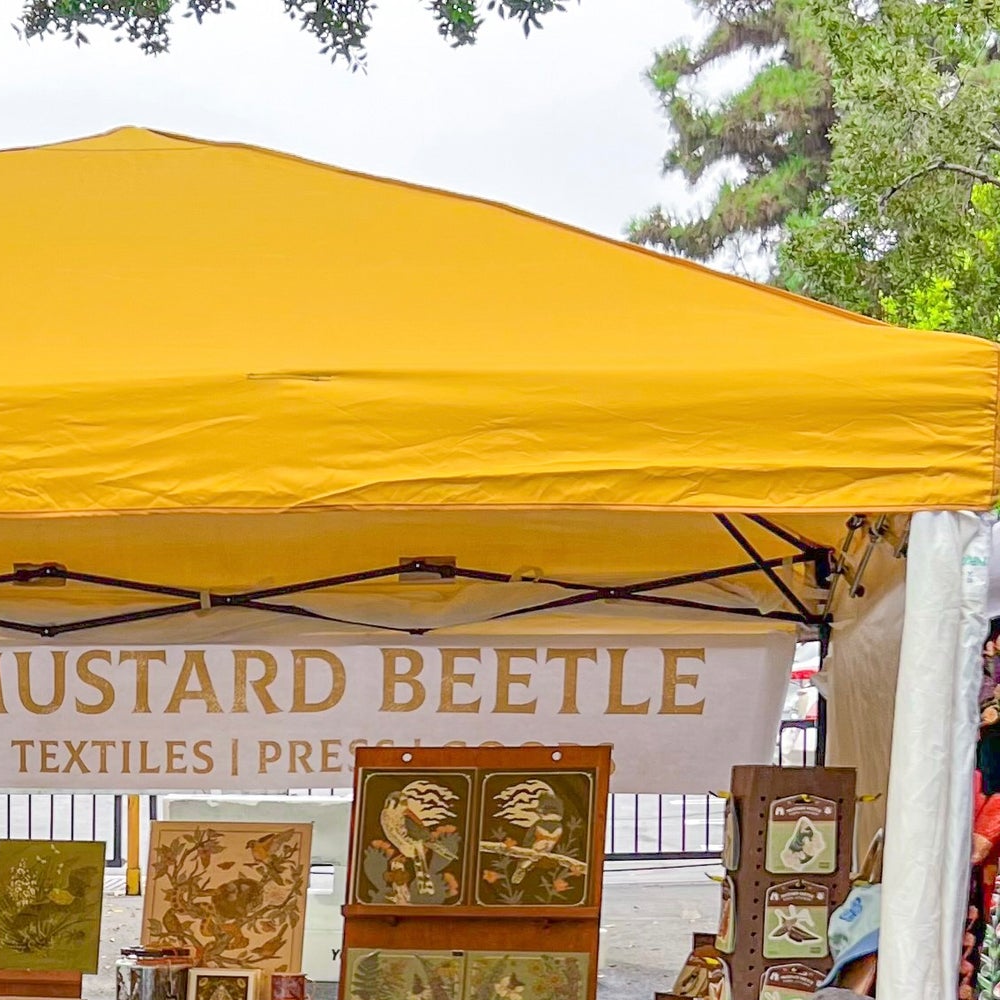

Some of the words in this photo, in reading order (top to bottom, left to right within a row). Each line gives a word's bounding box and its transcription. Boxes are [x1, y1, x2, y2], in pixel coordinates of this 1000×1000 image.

[378, 647, 706, 716] BEETLE
[11, 739, 214, 775] TEXTILES
[257, 738, 393, 775] PRE
